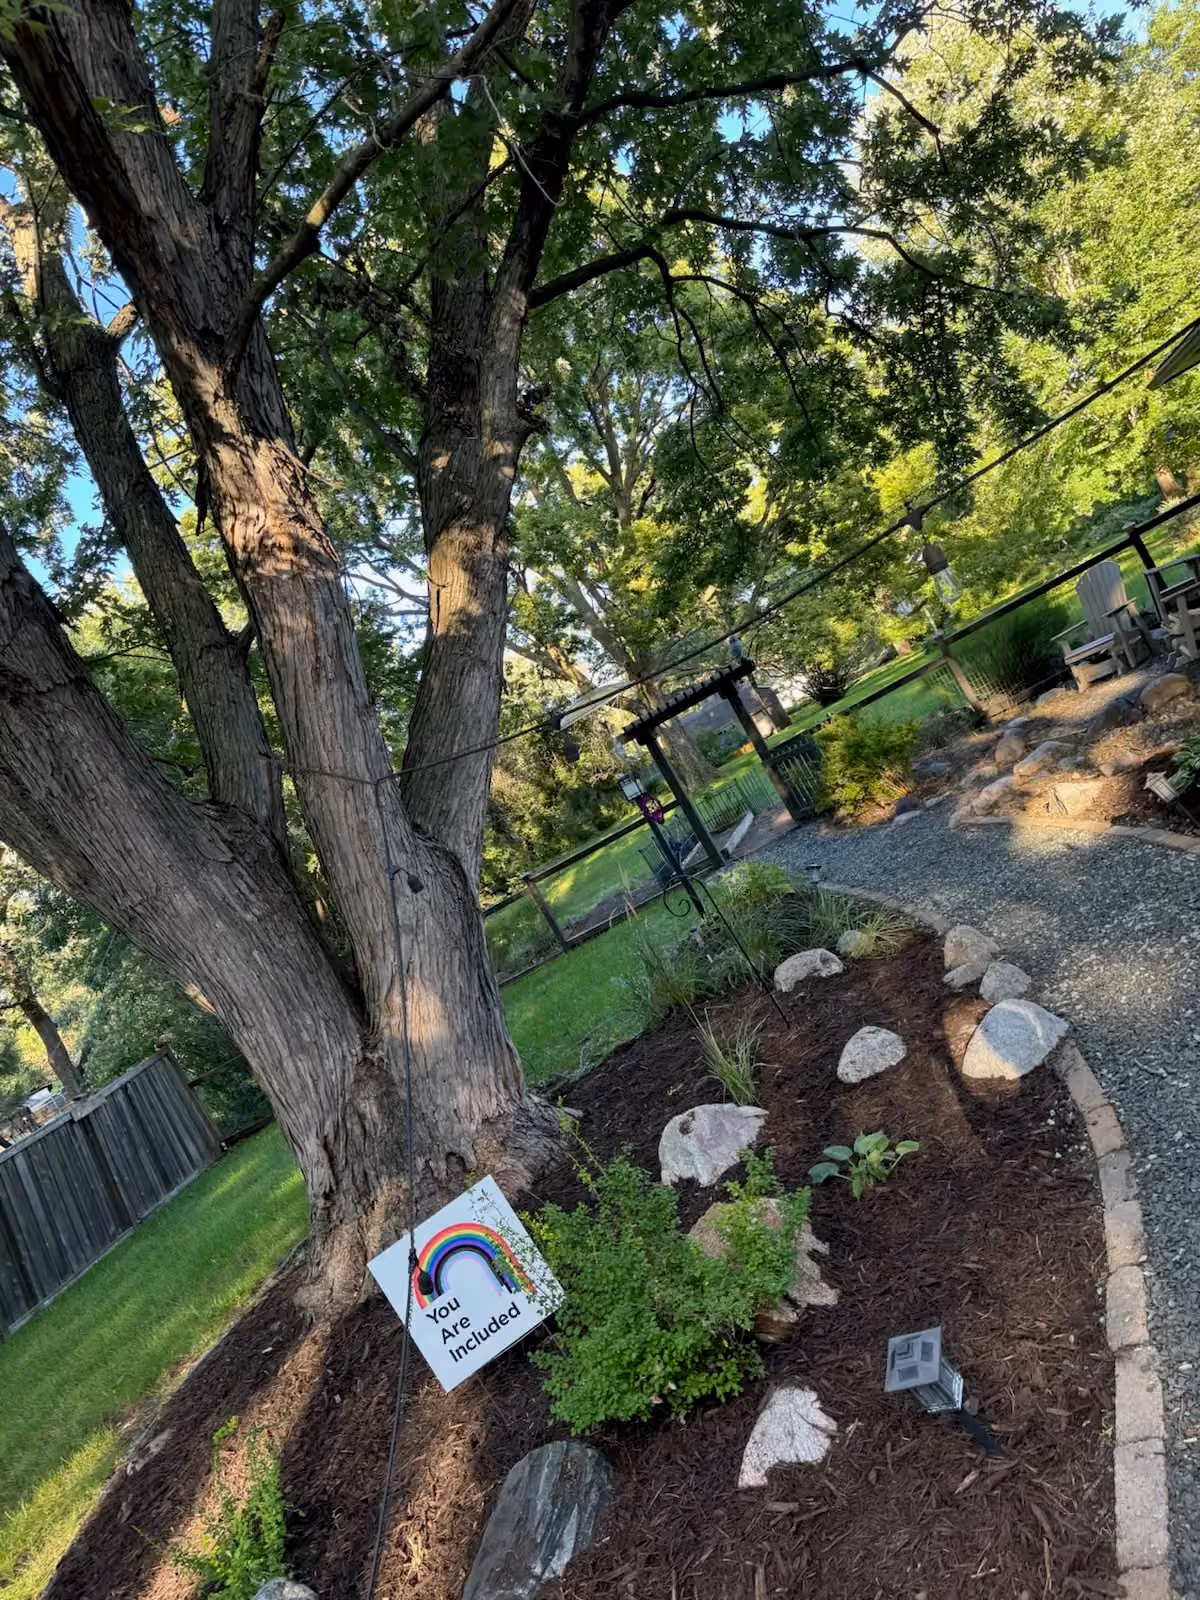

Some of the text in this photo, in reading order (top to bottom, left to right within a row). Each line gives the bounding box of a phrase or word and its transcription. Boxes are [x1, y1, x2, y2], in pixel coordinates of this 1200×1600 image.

[426, 1298, 460, 1325] You
[441, 1316, 471, 1344] Are
[449, 1302, 521, 1362] Included
